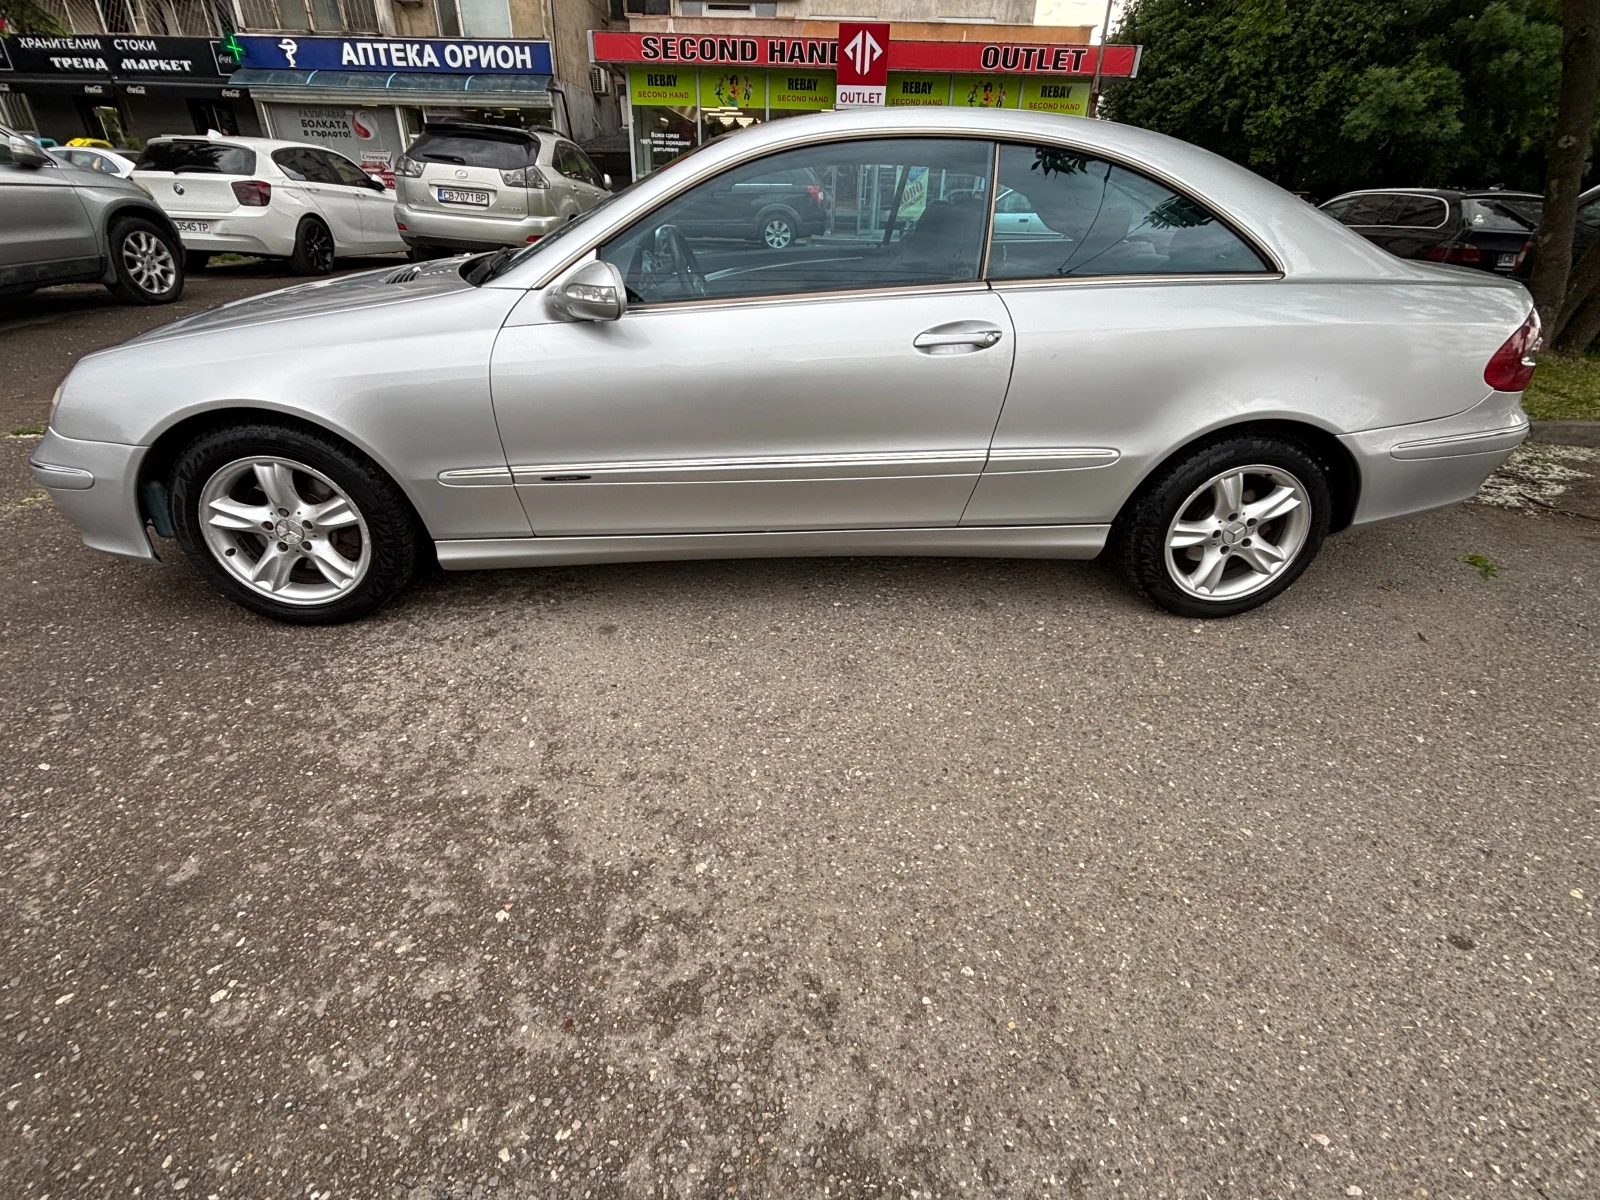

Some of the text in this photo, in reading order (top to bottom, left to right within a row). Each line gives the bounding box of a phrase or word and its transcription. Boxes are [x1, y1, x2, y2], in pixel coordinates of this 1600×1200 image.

[18, 37, 157, 51] ХРАНИТЕЛНИ СТОКИ
[641, 36, 758, 62] SECOND
[341, 42, 532, 69] АПТЕКА ОРИОН
[980, 45, 1088, 73] OUTLET
[49, 56, 192, 72] ТРЕНД МАРКЕТ
[647, 74, 678, 87] REBAY
[787, 78, 818, 91] REBAY
[902, 81, 933, 94] REBAY
[1040, 85, 1073, 99] REBAY
[637, 90, 689, 99] SECOND HAND
[777, 94, 829, 103] SECOND HAND
[840, 91, 882, 103] OUTLET
[891, 98, 920, 106] SECOND
[1028, 102, 1080, 111] SECOND HAND
[301, 119, 349, 130] БОЛКАТА
[311, 130, 352, 138] гърлото!
[197, 222, 208, 231] TP
